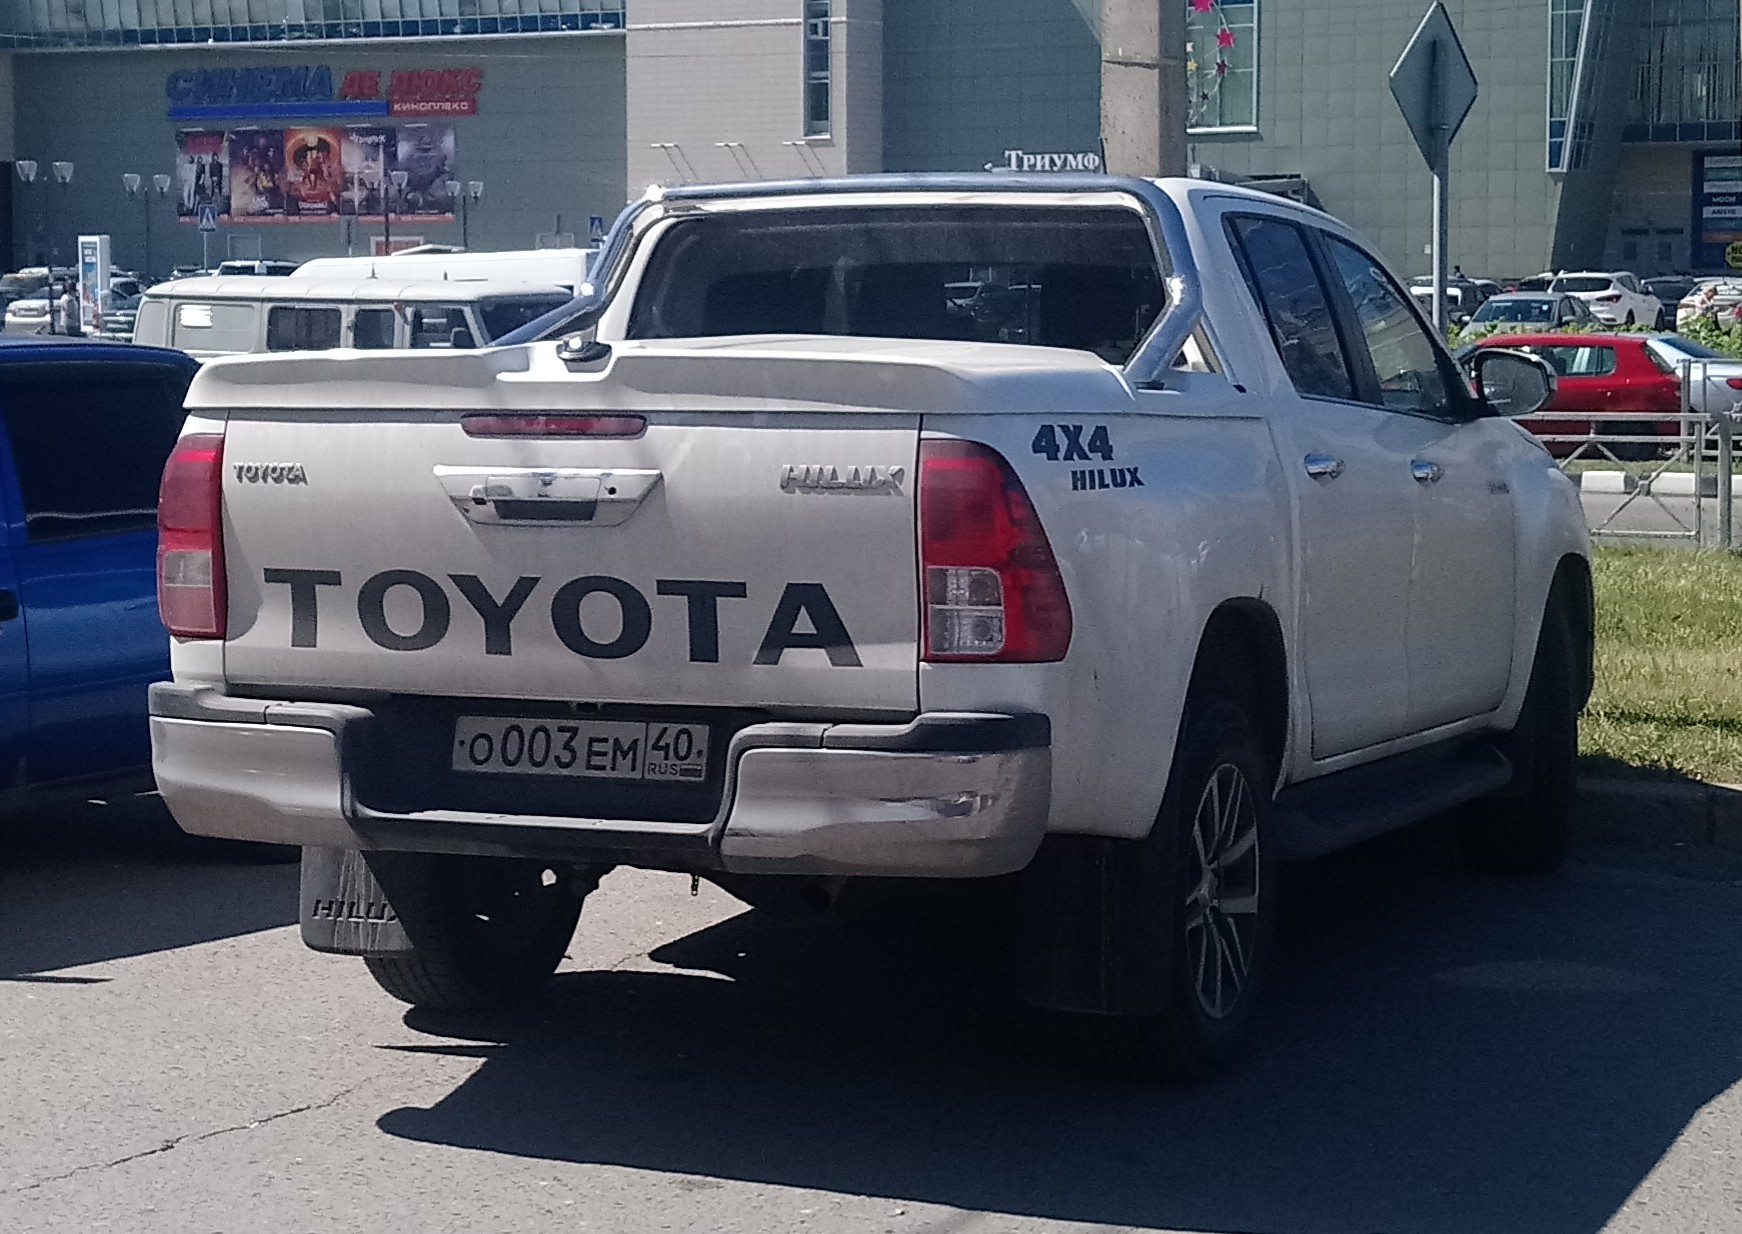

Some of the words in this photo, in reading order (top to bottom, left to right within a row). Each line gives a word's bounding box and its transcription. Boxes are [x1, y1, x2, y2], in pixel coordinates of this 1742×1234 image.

[393, 101, 470, 111] КИНОПЛЕКС
[1031, 424, 1115, 461] 4X4
[232, 461, 309, 486] TOYOTA
[780, 464, 905, 496] HILUX
[1070, 466, 1145, 491] HILUX
[263, 567, 864, 668] TOYOTA
[651, 726, 693, 761] 40
[647, 763, 679, 776] RUS
[311, 899, 397, 923] HILU
